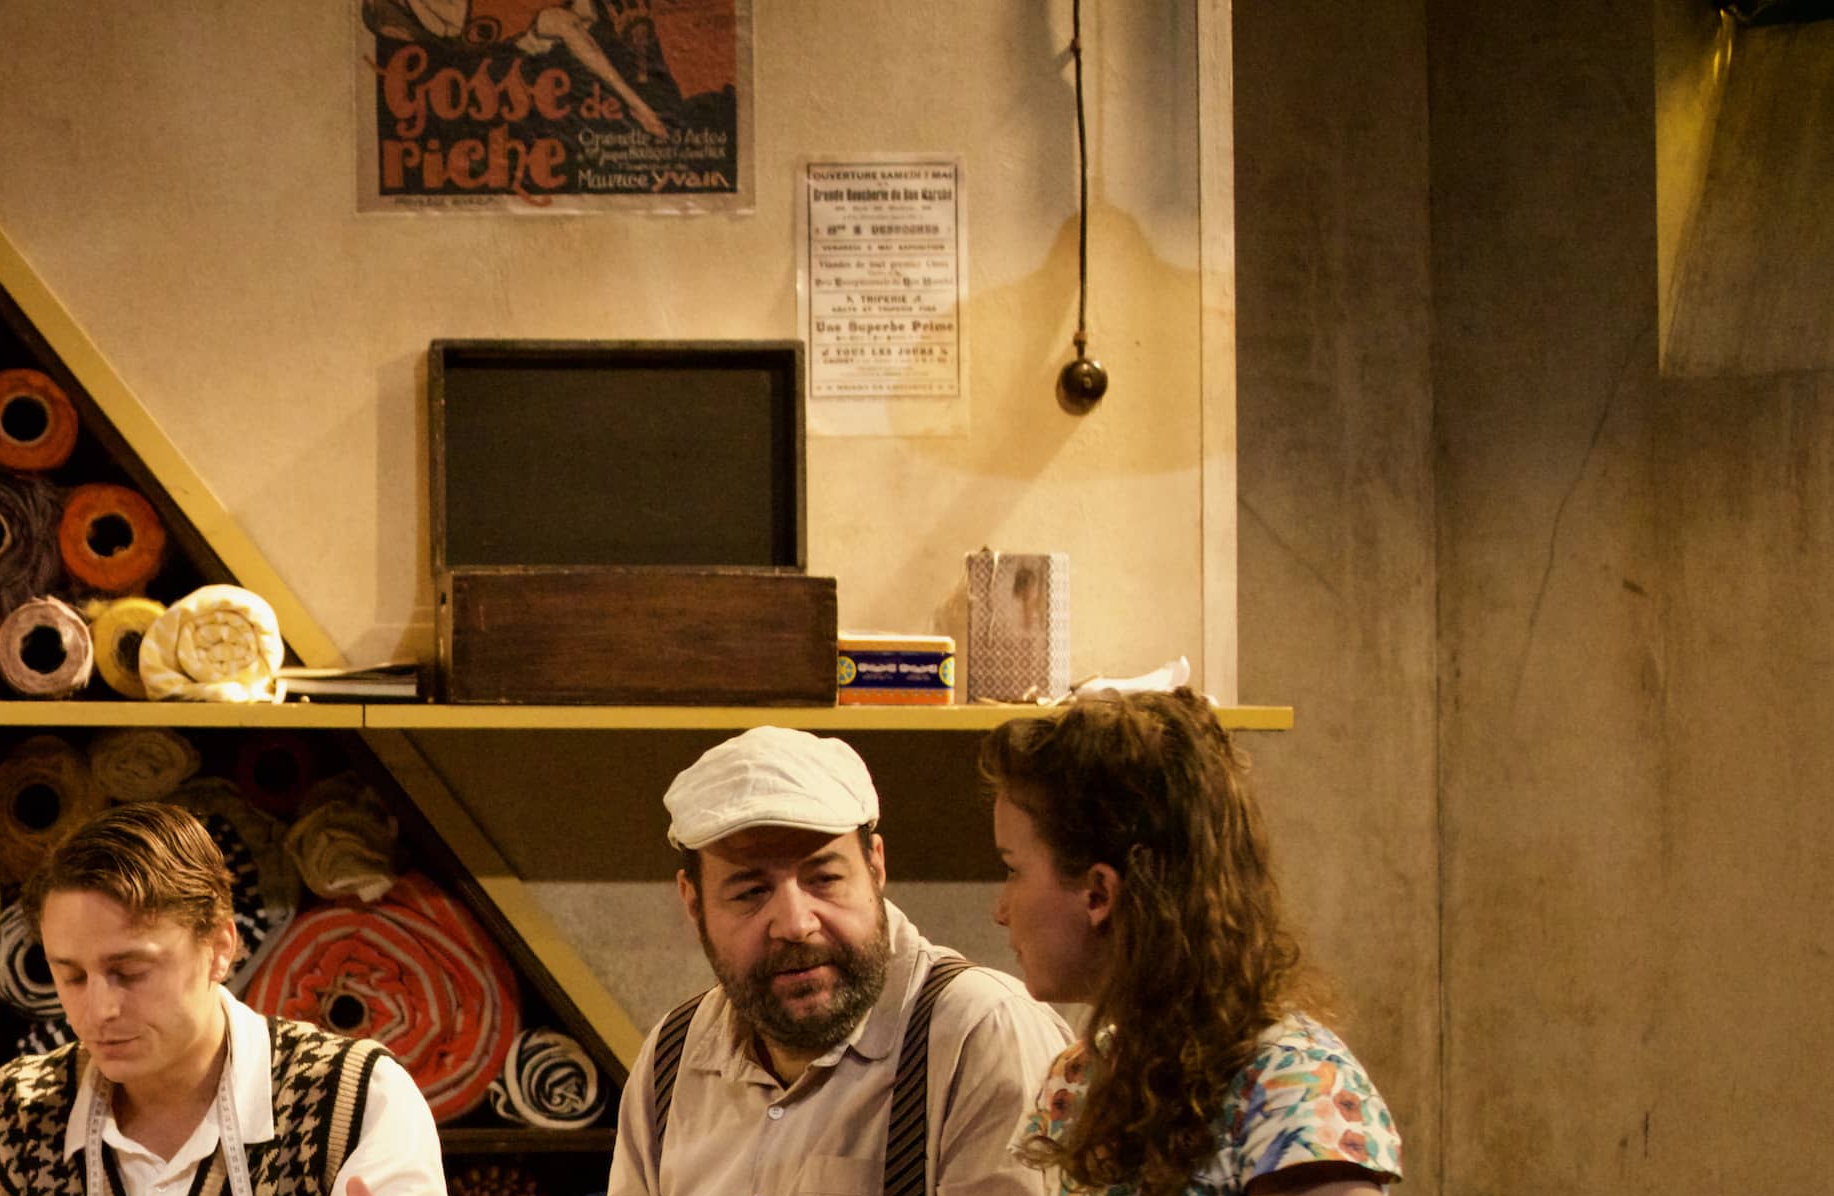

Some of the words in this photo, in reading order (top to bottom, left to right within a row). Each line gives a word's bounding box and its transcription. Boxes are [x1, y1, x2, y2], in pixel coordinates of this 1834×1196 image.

[363, 45, 571, 138] Gosse
[579, 82, 623, 121] de
[381, 122, 567, 207] riche
[578, 168, 649, 190] Maurice
[813, 171, 877, 180] OUVERTURE
[861, 295, 908, 304] TRIPERIE
[815, 320, 842, 333] Une
[848, 319, 905, 335] Superbe
[911, 319, 954, 333] Prime
